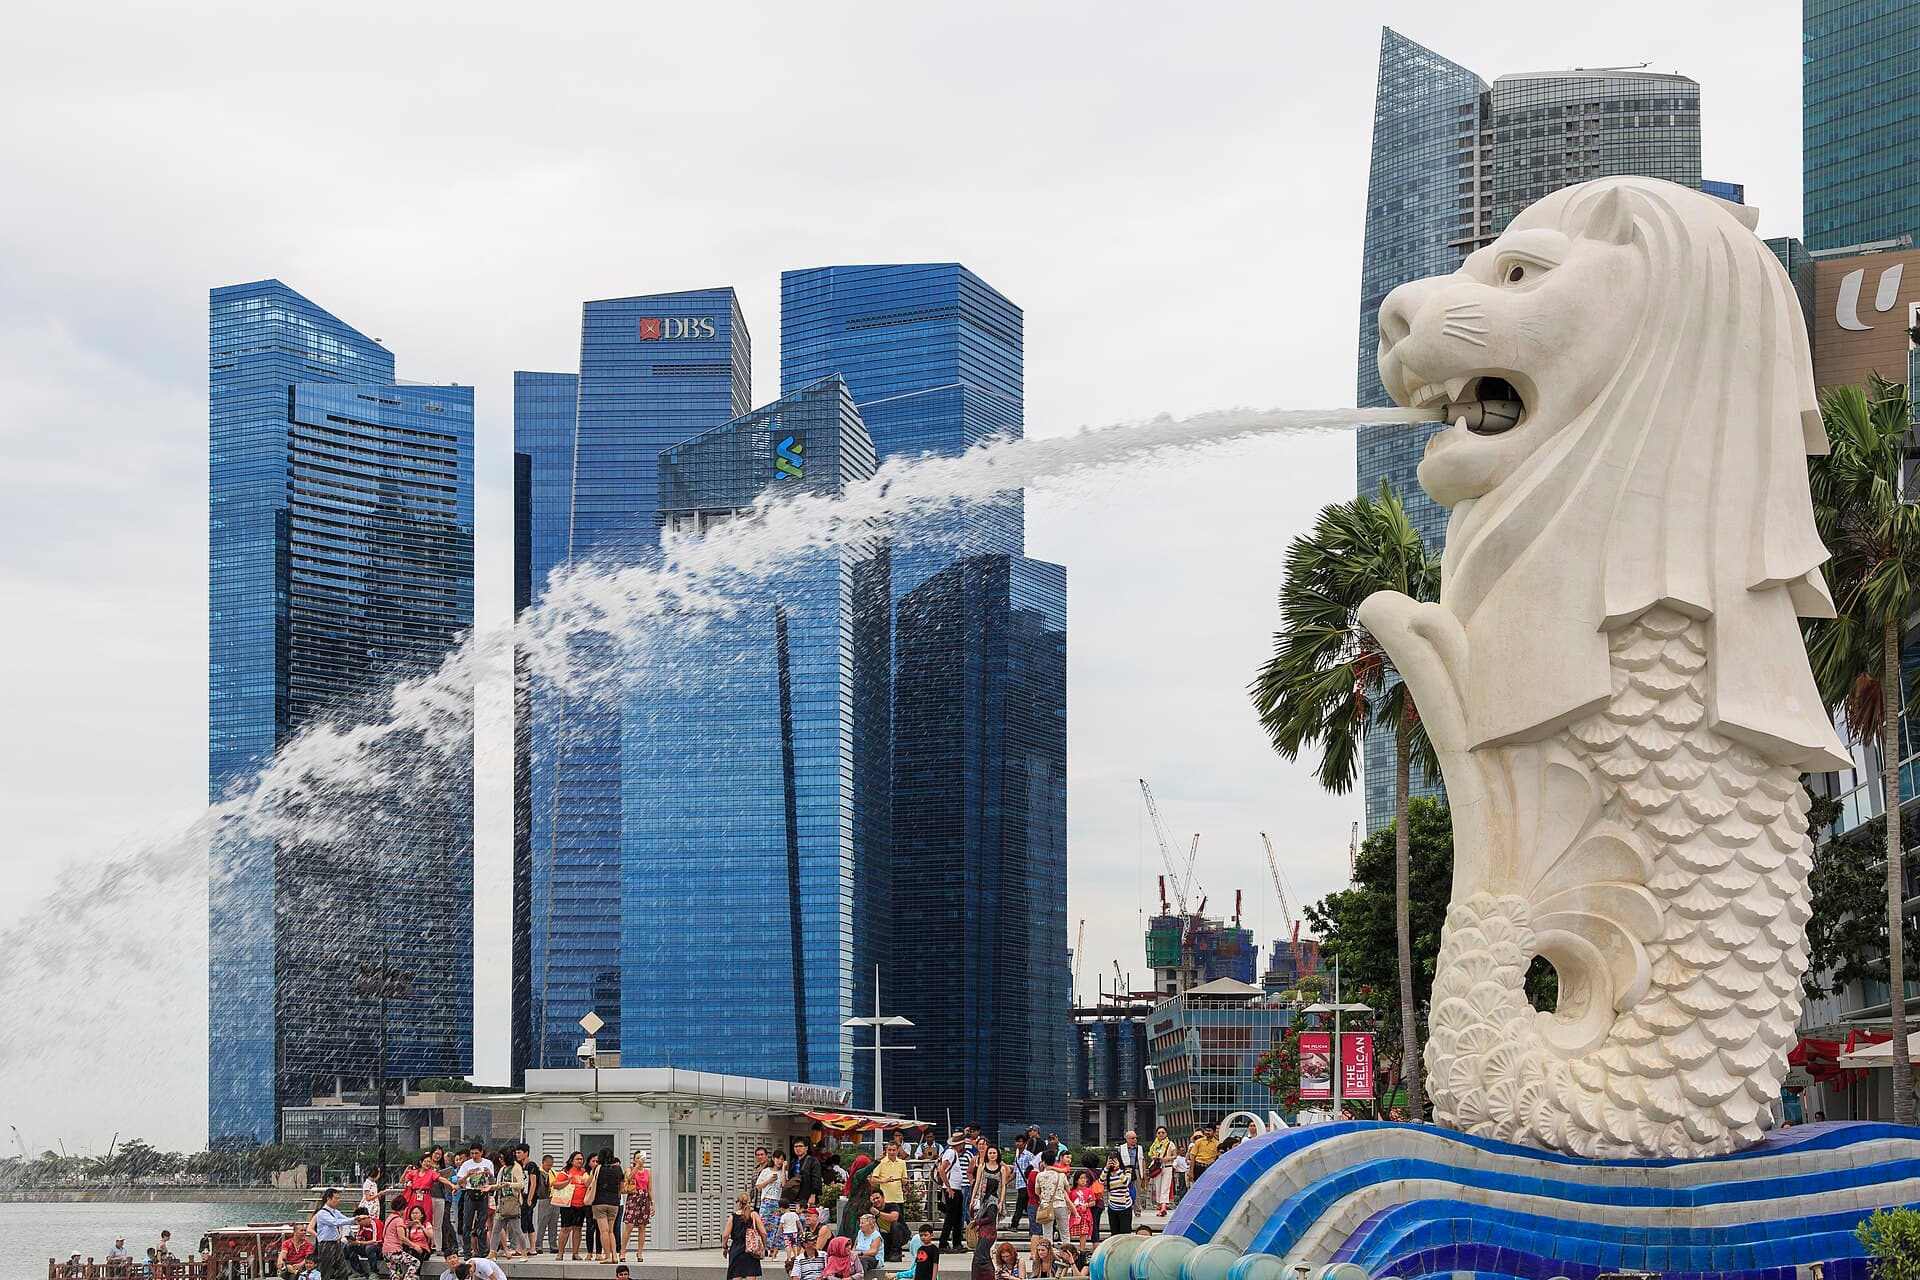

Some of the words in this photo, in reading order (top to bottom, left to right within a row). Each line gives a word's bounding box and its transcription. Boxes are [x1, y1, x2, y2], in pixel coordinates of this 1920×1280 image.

[663, 317, 715, 339] DBS
[1355, 1037, 1366, 1088] PELICAN
[1346, 1064, 1356, 1088] THE
